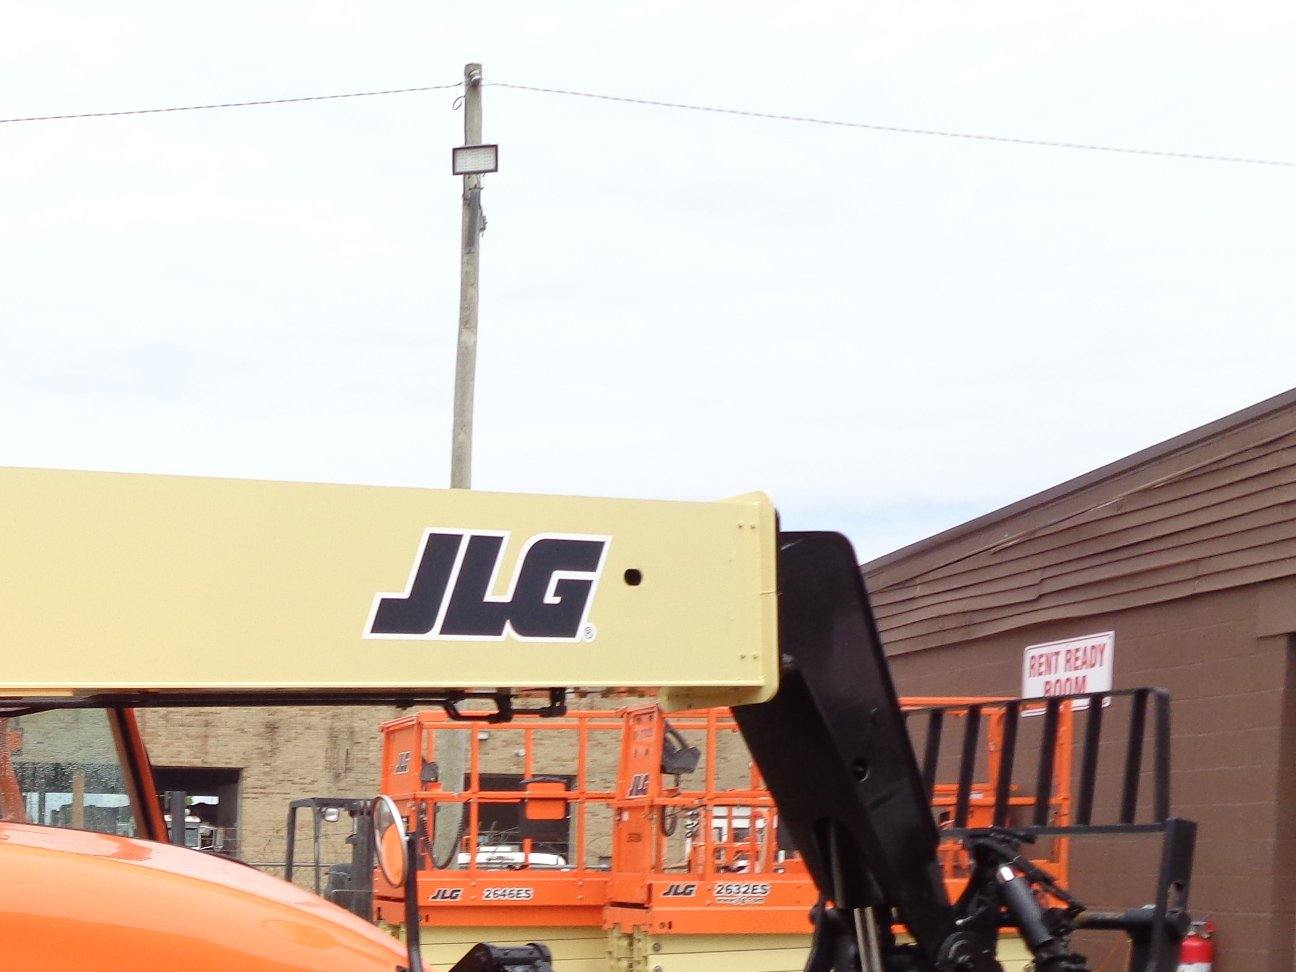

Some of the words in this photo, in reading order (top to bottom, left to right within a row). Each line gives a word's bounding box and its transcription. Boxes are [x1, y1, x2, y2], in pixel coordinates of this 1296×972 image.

[366, 530, 609, 640] JLG
[1028, 651, 1060, 677] RENT
[1065, 643, 1107, 671] READY
[1044, 675, 1088, 697] ROOM
[430, 888, 461, 901] JLG
[483, 887, 532, 900] 2646ES
[662, 883, 696, 897] JLG
[715, 883, 769, 896] 2632ES
